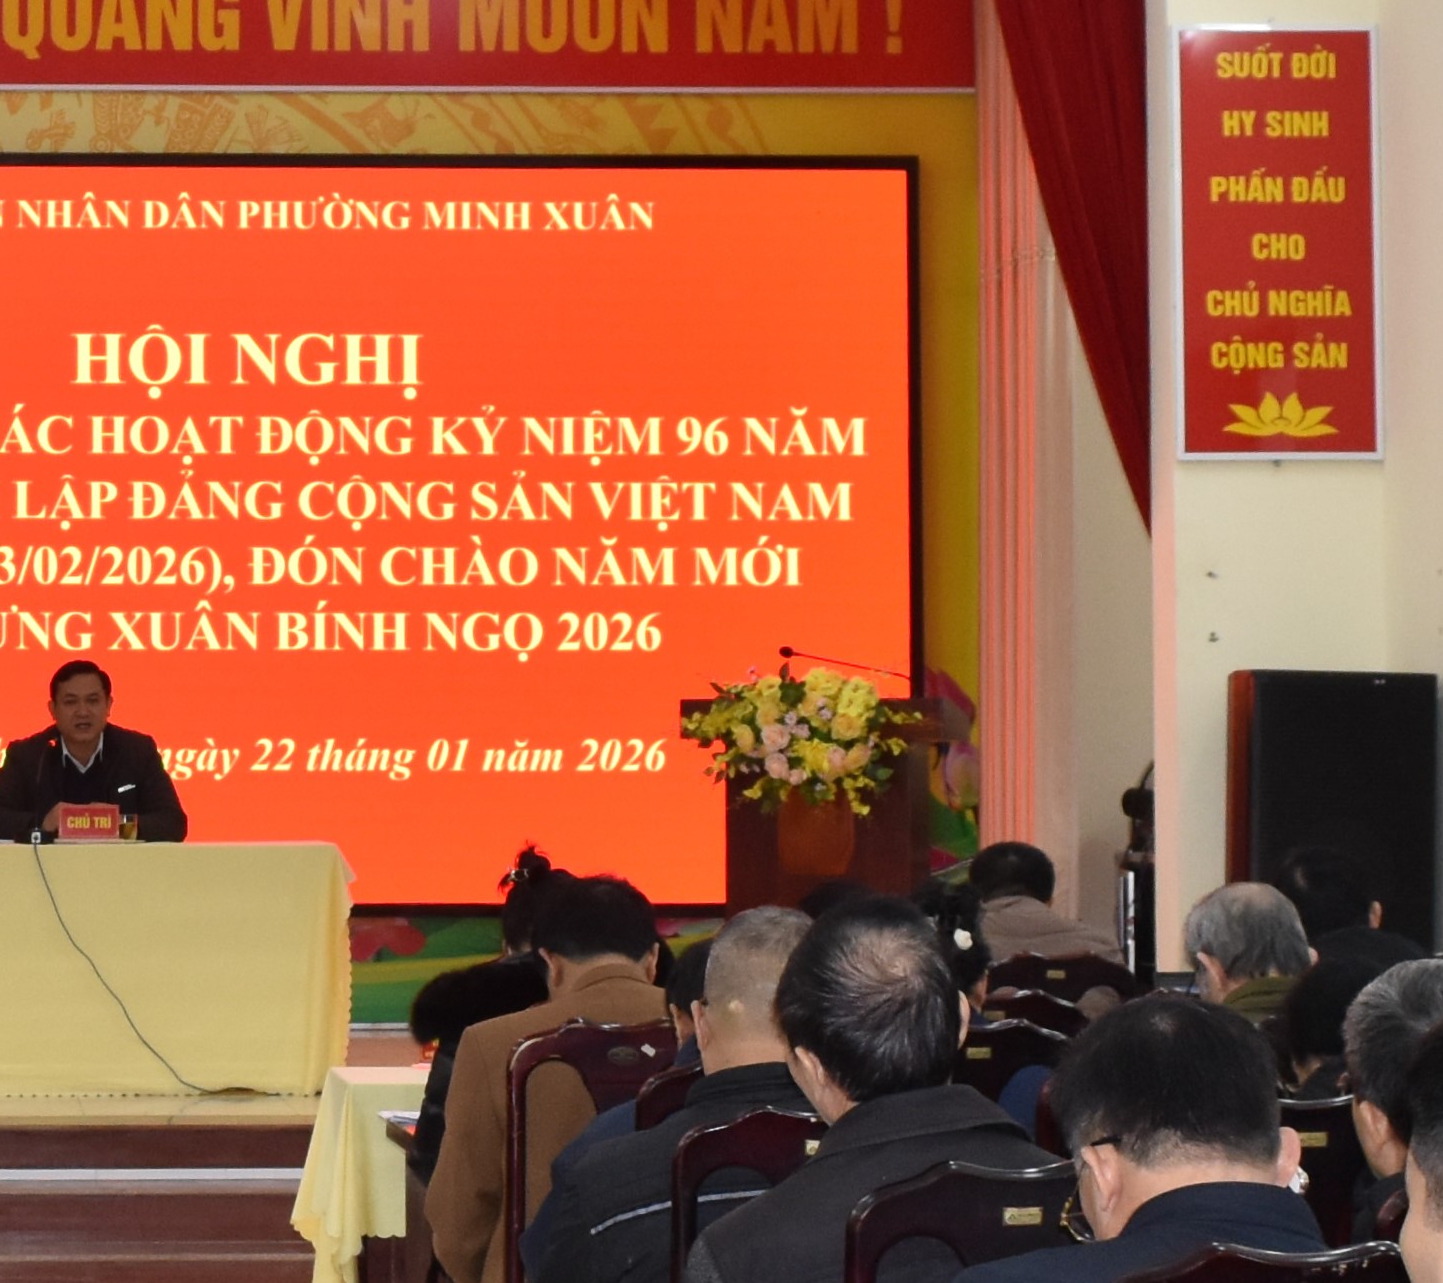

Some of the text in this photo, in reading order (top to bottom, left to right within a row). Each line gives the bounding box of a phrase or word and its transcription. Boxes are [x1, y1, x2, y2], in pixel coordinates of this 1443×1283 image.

[1216, 43, 1337, 79] SUỐT ĐỜI
[1222, 110, 1330, 138] HY SINH
[1209, 167, 1346, 203] PHẤN ĐẤU
[16, 191, 131, 229] NHÂN
[142, 191, 227, 230] DÂN
[237, 192, 412, 231] PHƯỜNG
[422, 201, 532, 231] MINH
[543, 192, 655, 232] XUÂN
[1251, 232, 1306, 261] CHO
[1205, 280, 1353, 318] CHỦ NGHĨA
[71, 323, 423, 401] HỘI NGHỊ
[1210, 332, 1348, 375] CỘNG SẢN
[90, 415, 245, 466] HOẠT
[254, 409, 414, 466] ĐỘNG
[429, 404, 507, 457] KỶ
[521, 409, 663, 467] NIỆM
[676, 416, 730, 457] 96
[743, 406, 867, 457] NĂM
[14, 474, 119, 530] LẬP
[127, 469, 285, 521] ĐẢNG
[296, 474, 457, 531] CỘNG
[469, 470, 575, 522] SẢN
[588, 475, 718, 531] VIỆT
[728, 481, 853, 522] NAM
[247, 534, 366, 586] ĐÓN
[379, 534, 540, 587] CHÀO
[552, 536, 677, 587] NĂM
[693, 535, 801, 587] MỚI
[107, 599, 261, 652] XUÂN
[275, 599, 409, 652] BÍNH
[424, 611, 545, 663] NGỌ
[557, 611, 663, 653] 2026
[249, 737, 296, 772] 22
[306, 737, 416, 781] tháng
[425, 738, 469, 773] 01
[481, 738, 565, 773] năm
[575, 737, 667, 773] 2026
[66, 812, 91, 830] CHỦ
